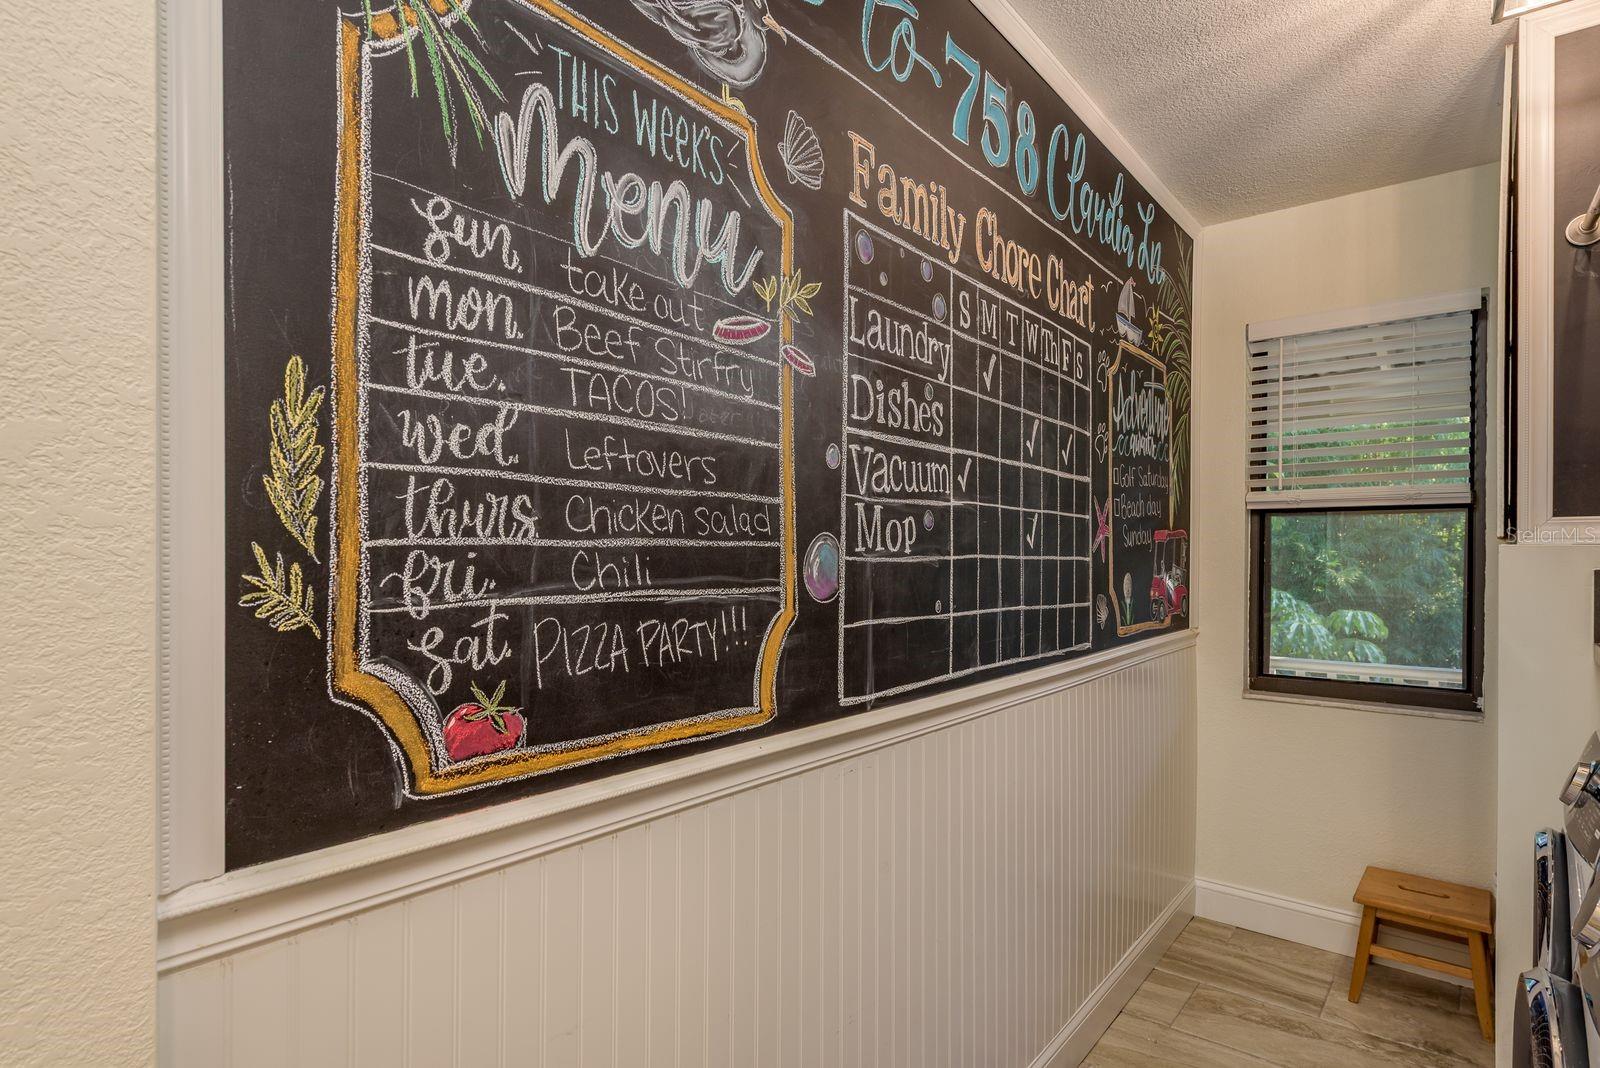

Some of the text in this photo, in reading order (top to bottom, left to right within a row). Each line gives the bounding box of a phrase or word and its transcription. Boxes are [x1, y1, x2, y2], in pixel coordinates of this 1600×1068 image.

[547, 44, 618, 134] THIS
[945, 31, 1039, 197] 758
[847, 130, 1096, 332] Family Chore Chart
[553, 304, 643, 365] Beef
[654, 294, 705, 331] out
[849, 295, 951, 383] Laundry
[958, 290, 1084, 380] S M T W Th F S
[559, 367, 687, 421] TACOS!
[850, 374, 944, 437] Dishes
[564, 428, 717, 485] Leftovers
[849, 444, 951, 496] Vacuum
[1120, 463, 1169, 495] Golf Saturday
[565, 494, 685, 536] Chicken
[697, 501, 772, 537] salad
[854, 502, 917, 554] Mop
[1121, 493, 1162, 520] Beach day
[1122, 523, 1152, 552] Sunday
[570, 550, 652, 592] Chili
[533, 616, 630, 690] PIZZA
[636, 605, 748, 667] PARTY!!!
